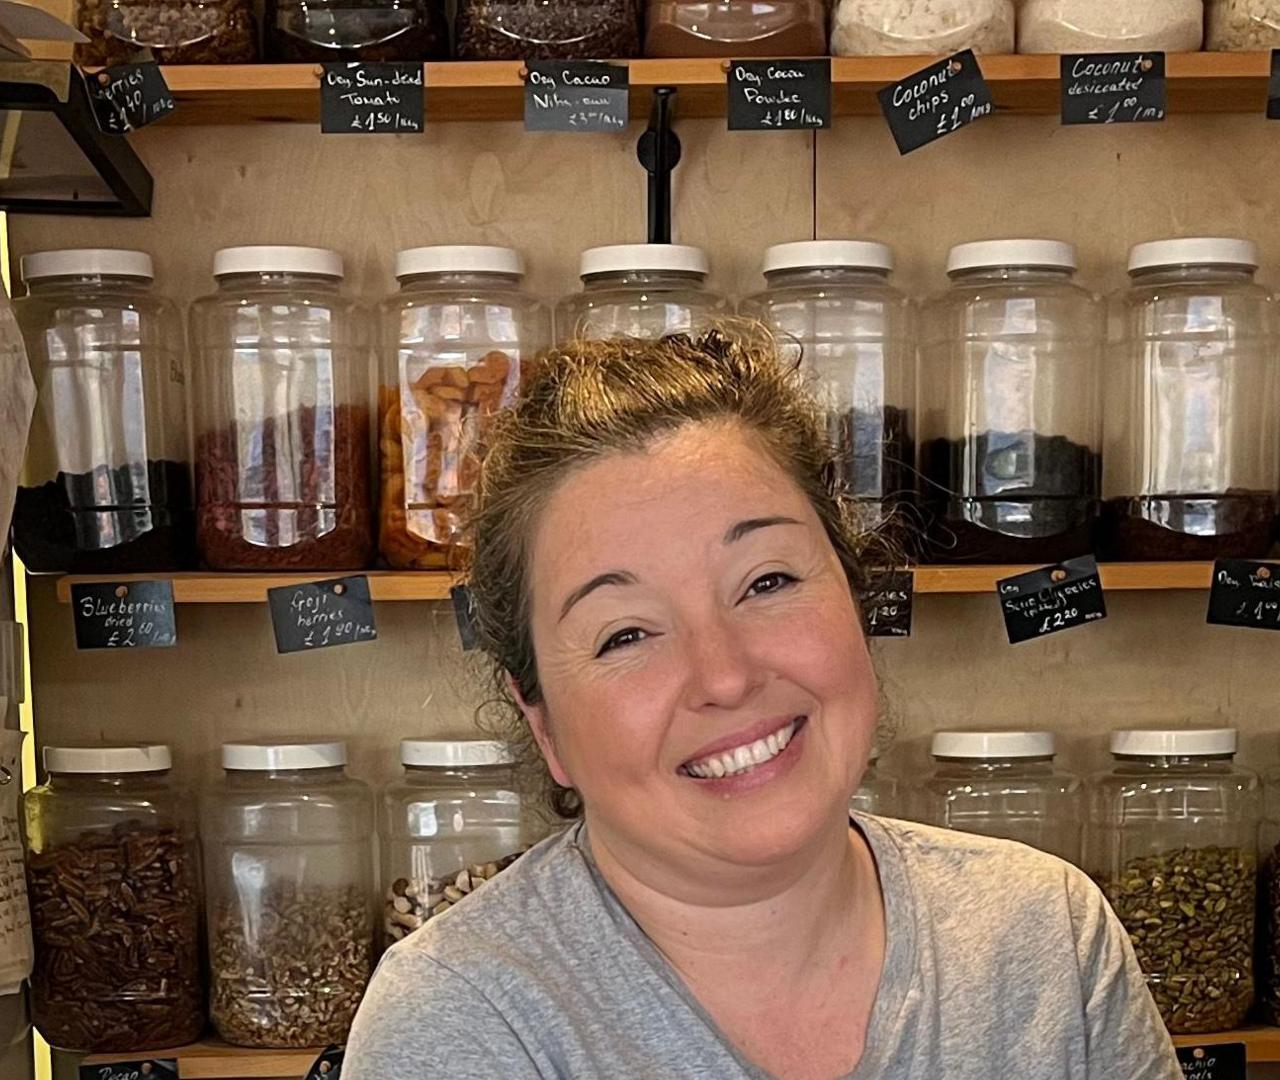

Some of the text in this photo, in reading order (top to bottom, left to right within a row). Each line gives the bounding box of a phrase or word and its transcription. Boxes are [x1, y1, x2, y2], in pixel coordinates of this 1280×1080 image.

[1072, 55, 1143, 77] Coconut
[892, 59, 955, 107] Coconut
[908, 90, 950, 122] chips
[79, 595, 167, 618] Blueberries
[105, 614, 134, 628] dried
